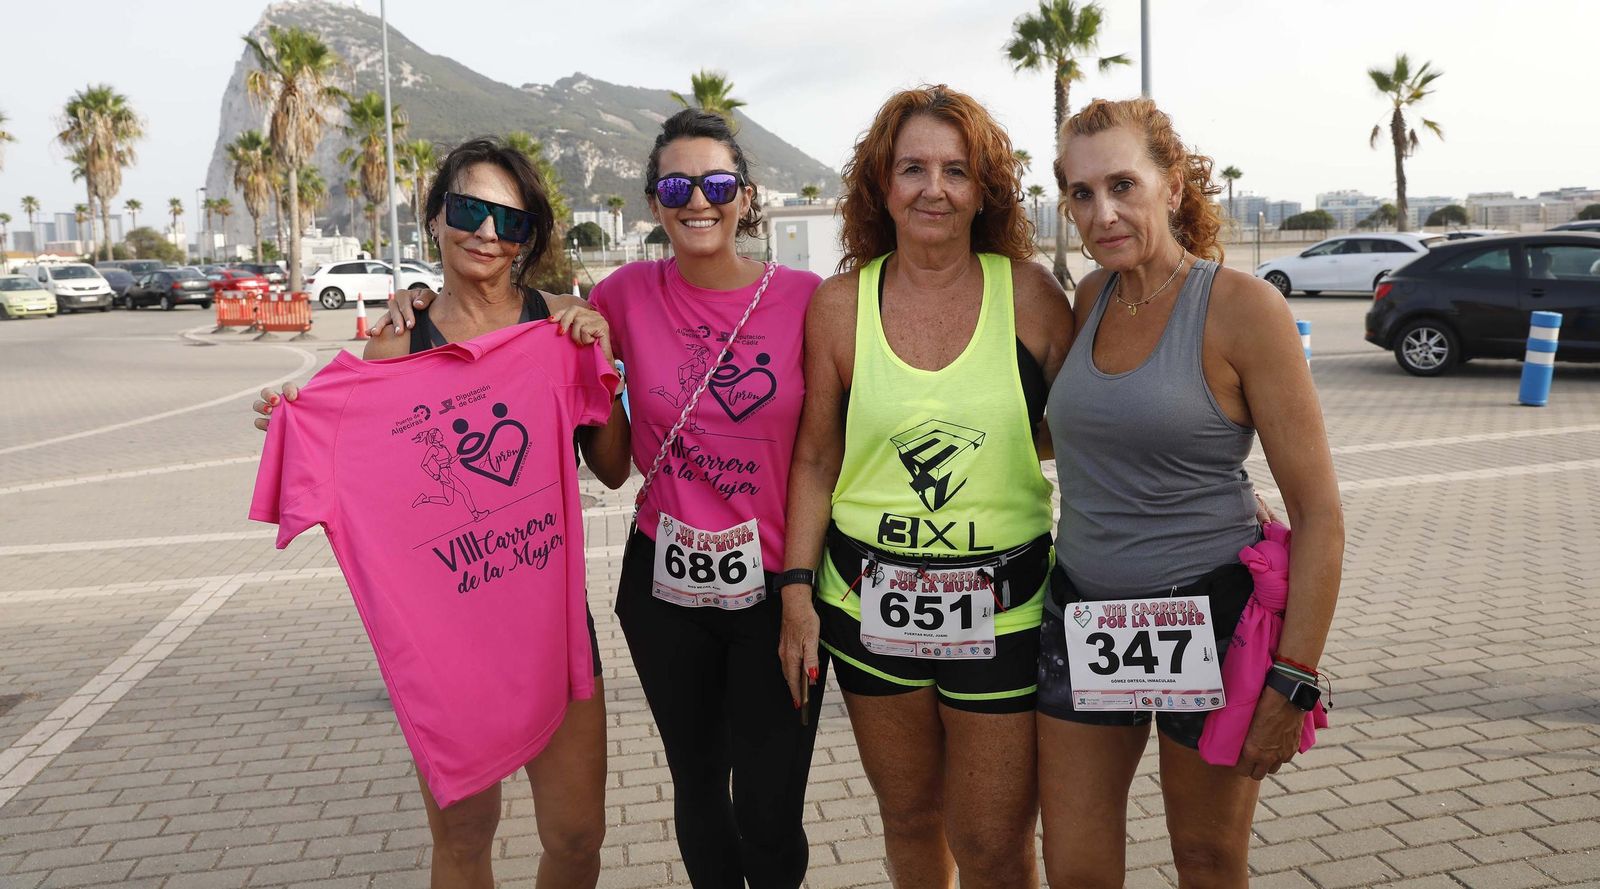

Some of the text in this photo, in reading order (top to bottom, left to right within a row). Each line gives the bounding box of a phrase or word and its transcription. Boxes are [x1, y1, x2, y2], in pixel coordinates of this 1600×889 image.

[455, 384, 491, 402] Diputación
[458, 393, 487, 408] de Cádiz
[391, 418, 424, 436] Algeciras
[395, 416, 412, 427] Puerto
[682, 444, 761, 475] Carrera
[678, 462, 697, 481] la
[700, 471, 761, 501] Mujer
[432, 511, 558, 573] VIII Carrera
[675, 532, 755, 553] POR LA MUJER
[697, 524, 750, 545] CARRERA
[457, 534, 564, 594] de la Mujer
[665, 543, 748, 585] 686
[890, 579, 989, 593] POR LA MUJER
[880, 592, 972, 631] 651
[1131, 600, 1199, 616] CARRERA
[1097, 612, 1206, 629] POR LA MUJER
[1085, 629, 1192, 676] 347
